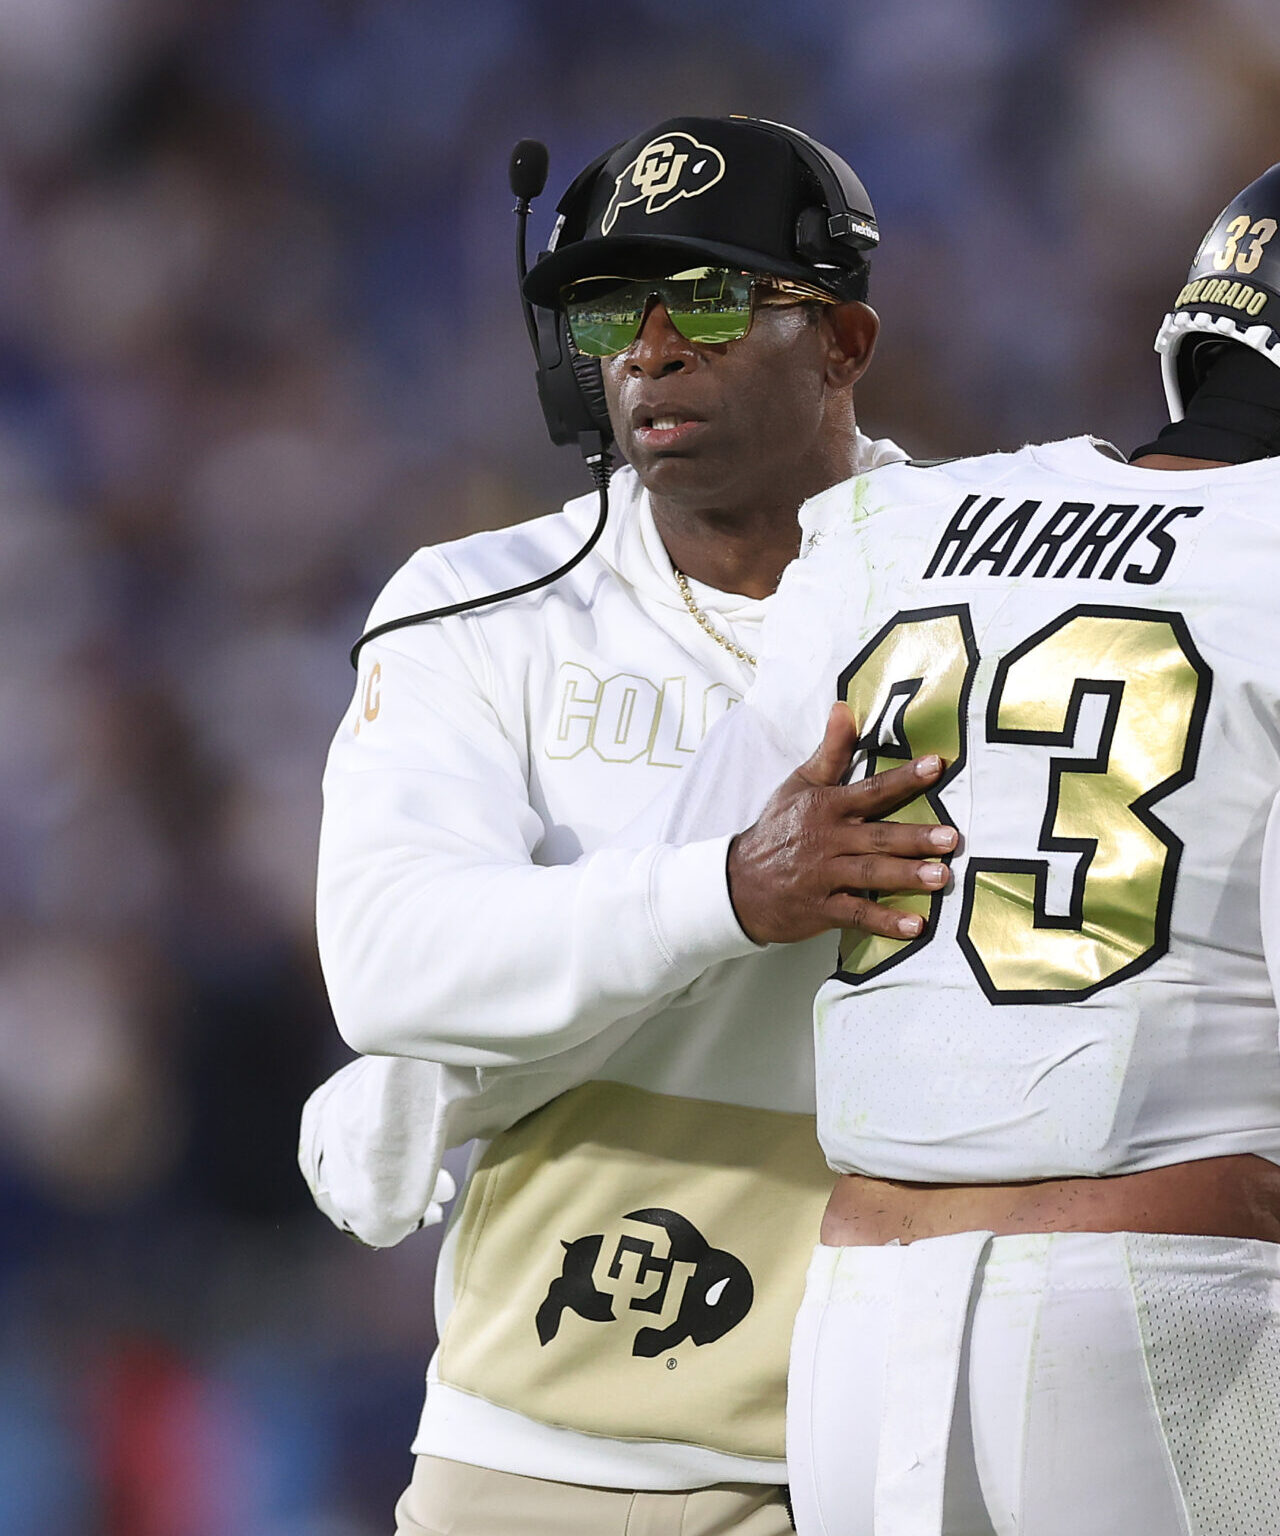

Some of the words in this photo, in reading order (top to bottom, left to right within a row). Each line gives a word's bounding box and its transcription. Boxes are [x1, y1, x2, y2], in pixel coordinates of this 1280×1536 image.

[632, 142, 689, 195] CU
[1212, 215, 1278, 274] 33
[1174, 279, 1268, 316] COLORADO
[923, 494, 1204, 585] HARRIS
[837, 603, 1213, 1006] 33
[591, 1217, 697, 1332] CU
